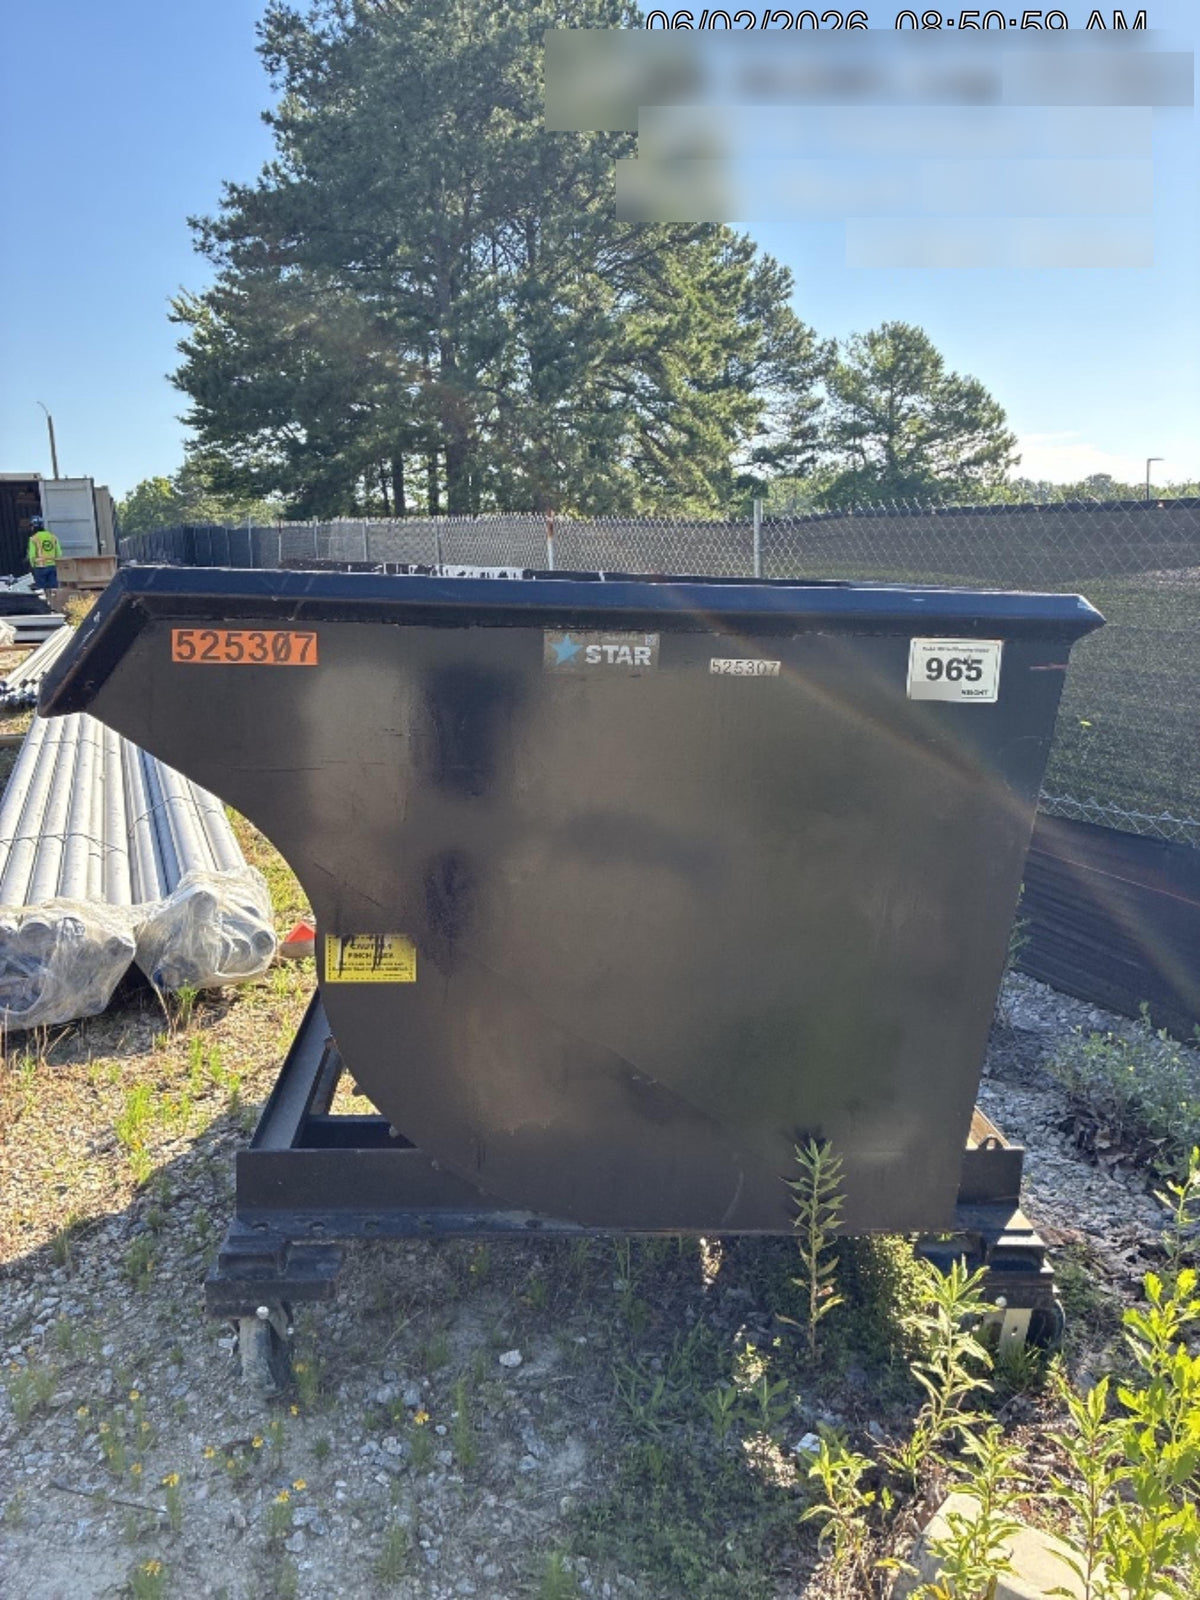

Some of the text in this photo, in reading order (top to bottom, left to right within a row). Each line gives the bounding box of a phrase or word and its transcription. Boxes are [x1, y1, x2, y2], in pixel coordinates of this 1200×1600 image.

[176, 630, 315, 663] 525307
[584, 644, 652, 666] STAR
[712, 660, 778, 676] 525307
[926, 656, 984, 682] 965
